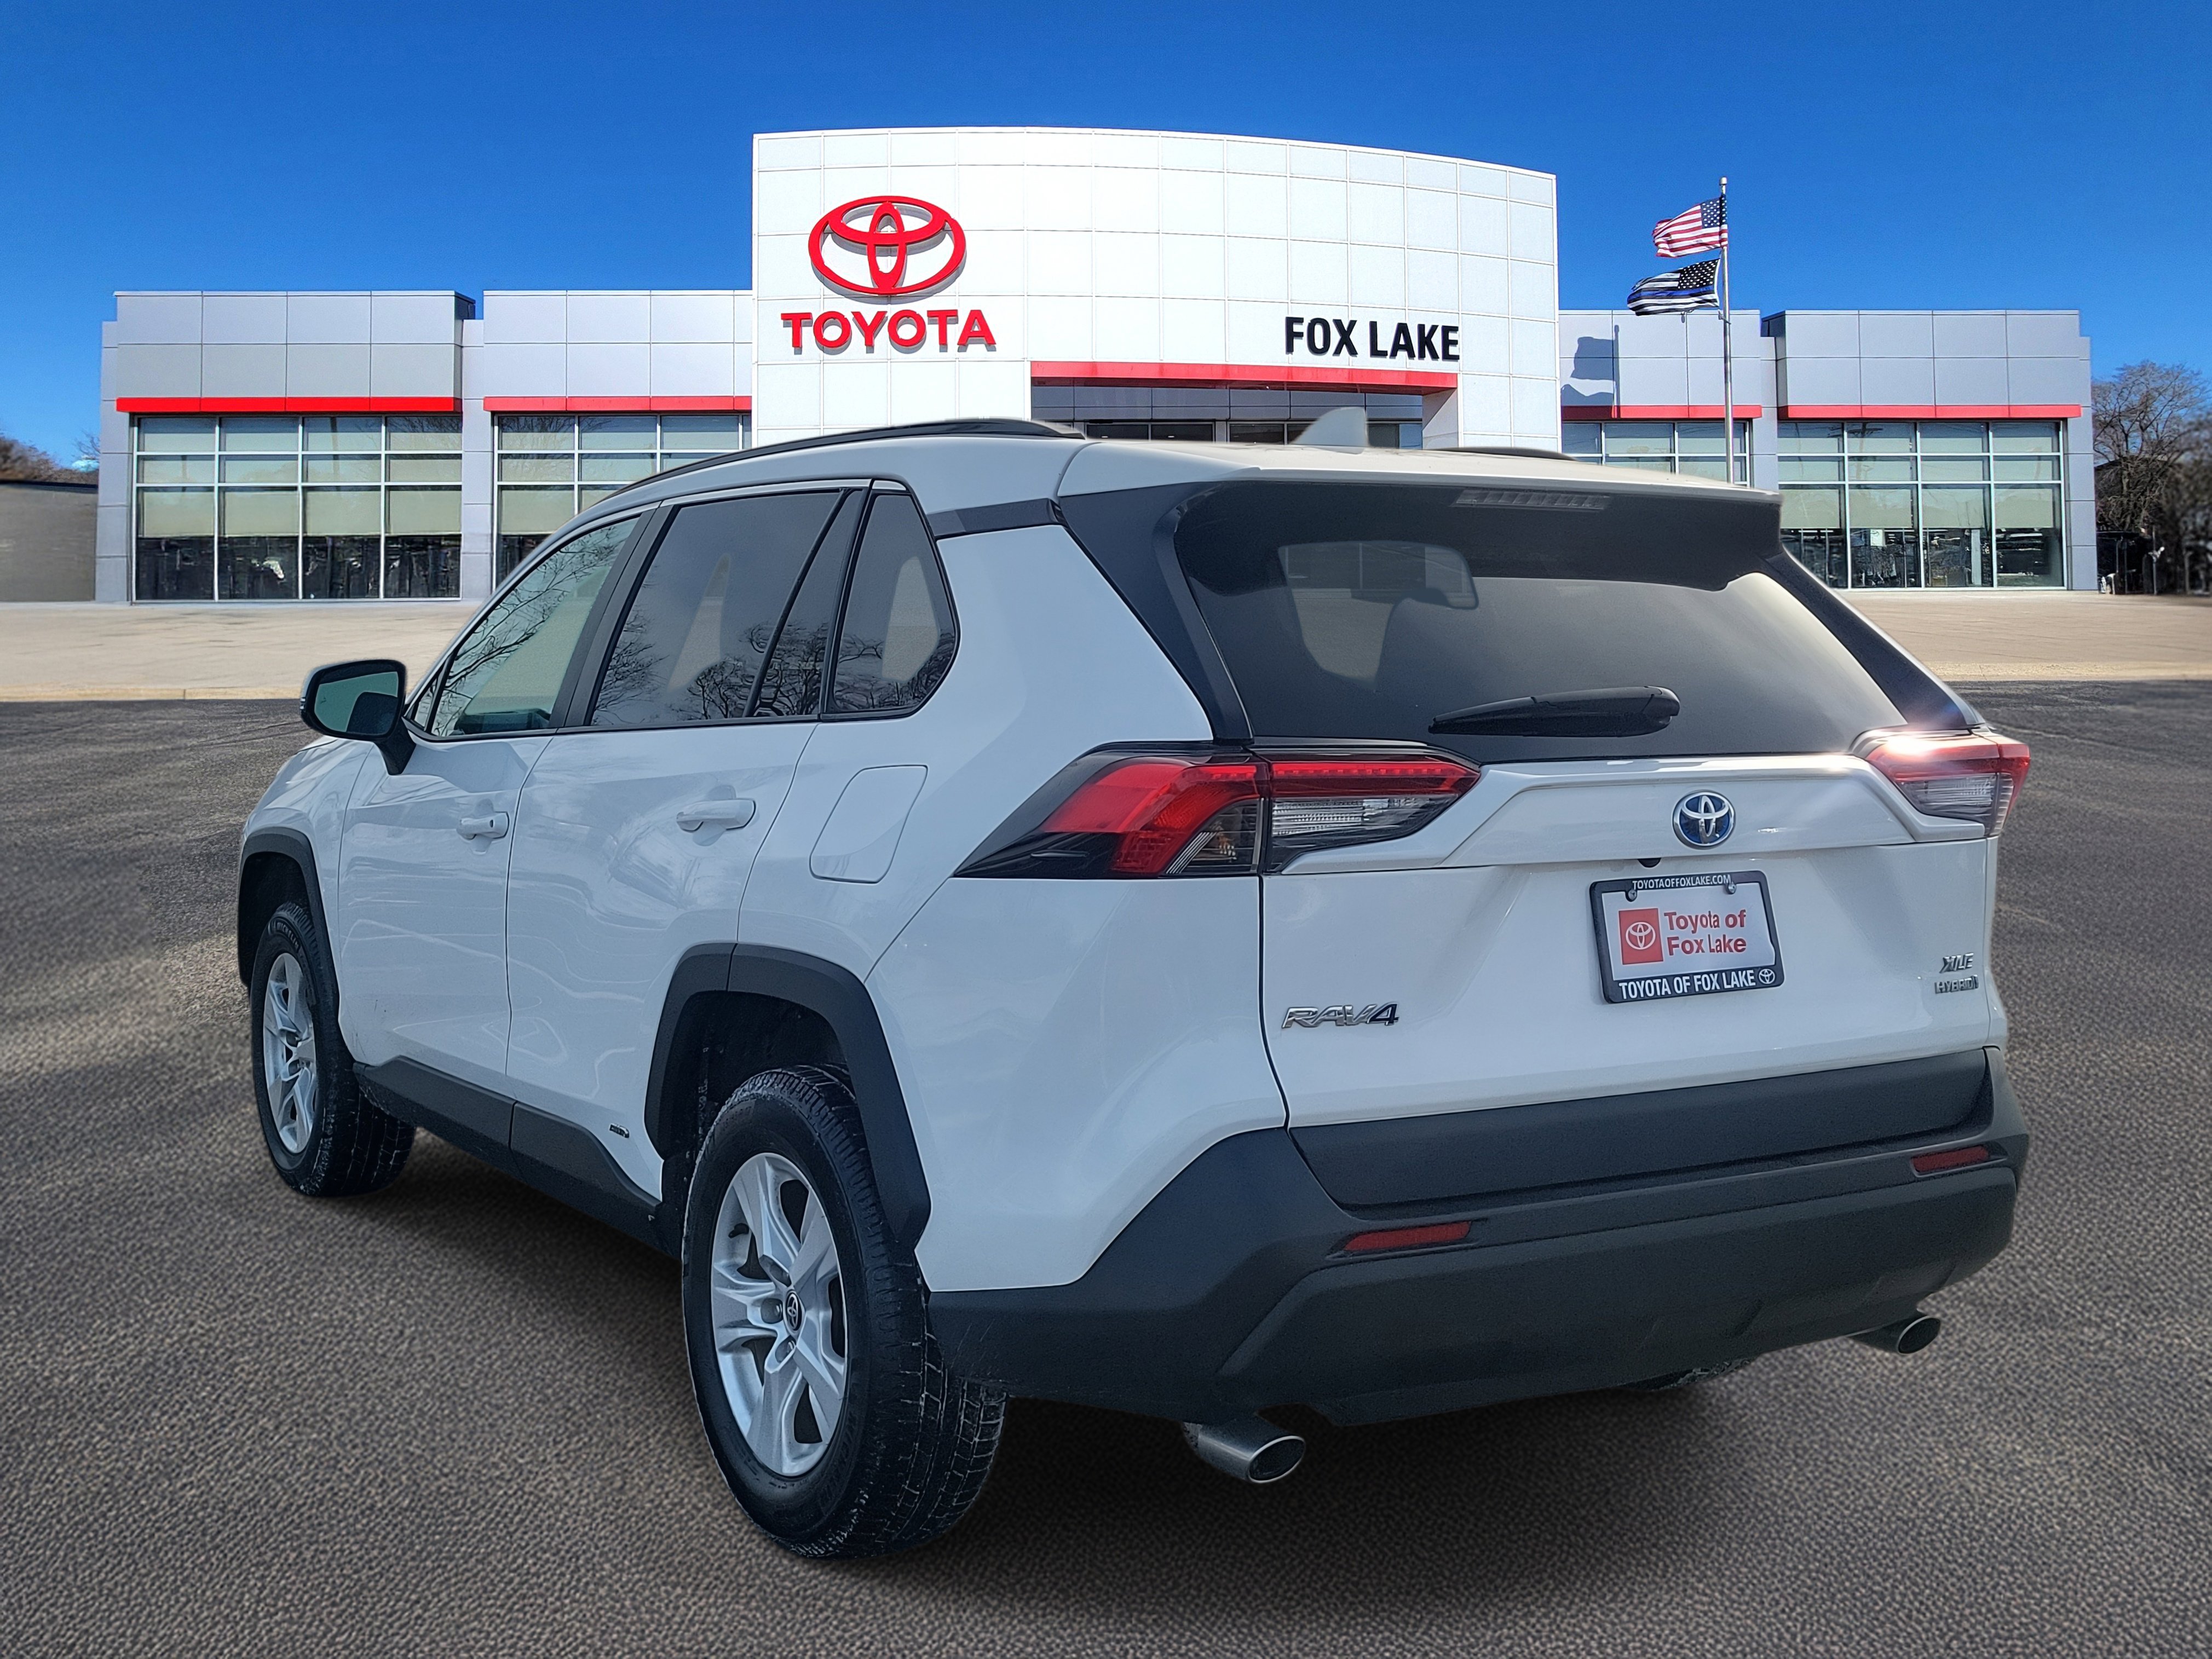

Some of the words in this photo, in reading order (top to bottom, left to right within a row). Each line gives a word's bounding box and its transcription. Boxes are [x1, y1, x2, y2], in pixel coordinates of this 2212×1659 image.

[781, 309, 997, 353] TOYOTA
[1285, 316, 1358, 356] FOX
[1369, 320, 1460, 361] LAKE
[1632, 874, 1731, 890] TOYOTAOFFOXLAKE.COM
[1664, 910, 1720, 934] Toyota
[1725, 909, 1747, 929] of
[1667, 936, 1706, 957] Fox
[1708, 934, 1747, 954] Lake
[1939, 952, 1974, 973] XLE
[1618, 978, 1672, 1000] TOYOTA
[1673, 976, 1691, 994] OF
[1693, 973, 1720, 992] FOX
[1722, 969, 1756, 989] LAKE
[1282, 1001, 1399, 1029] RAV4
